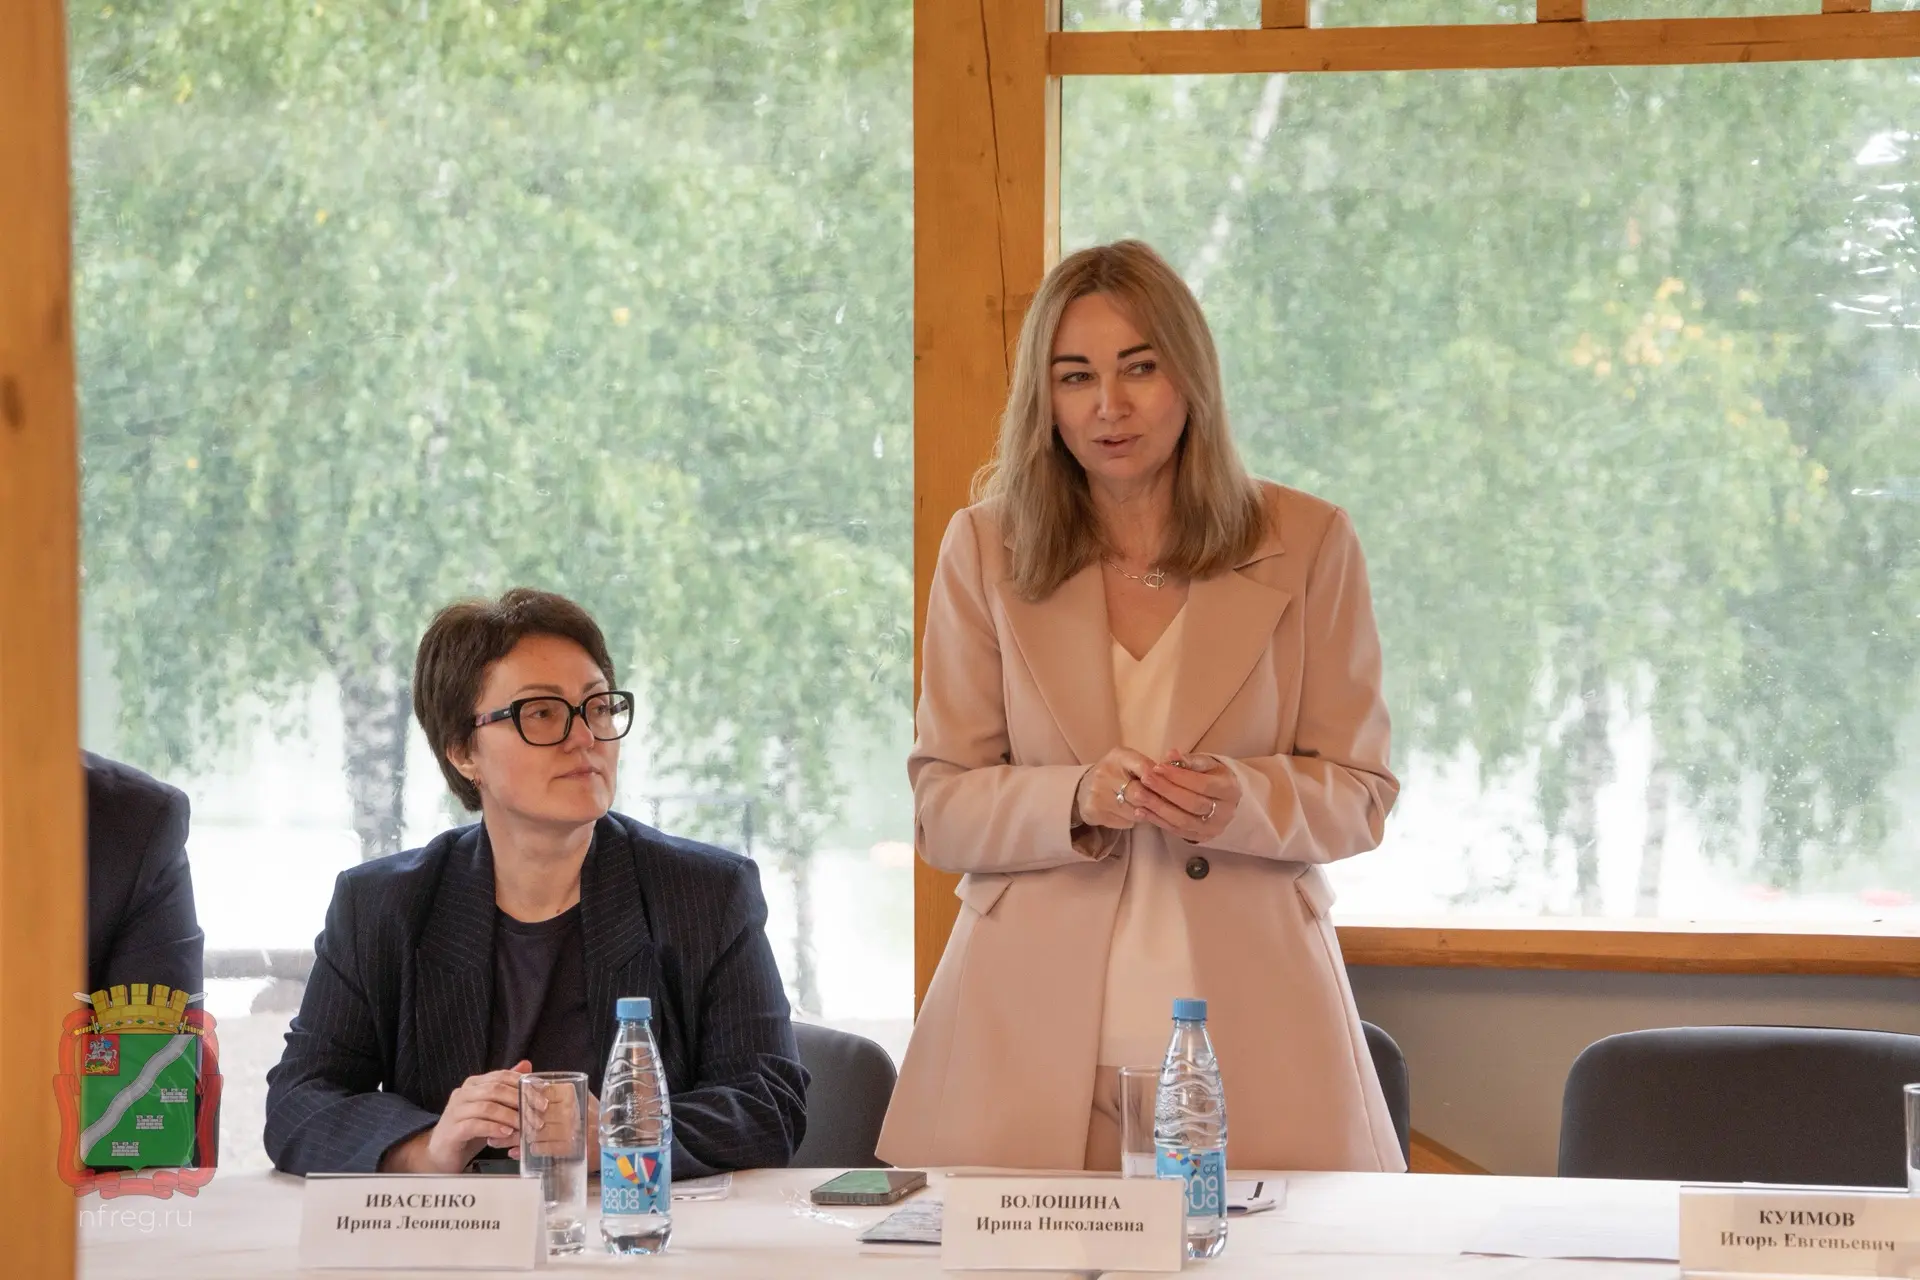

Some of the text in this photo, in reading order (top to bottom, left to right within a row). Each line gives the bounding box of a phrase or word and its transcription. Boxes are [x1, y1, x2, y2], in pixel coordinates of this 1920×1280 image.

[604, 1185, 640, 1199] bona
[365, 1193, 476, 1209] ИВАСЕНКО
[604, 1199, 640, 1212] aqua
[999, 1194, 1122, 1210] ВОЛОШИНА
[336, 1215, 501, 1233] Ирина Леонидовна
[976, 1216, 1145, 1234] Ирина Николаевна
[1759, 1210, 1856, 1227] КУИМОВ
[1720, 1231, 1896, 1252] Игорь Евгеньевич
